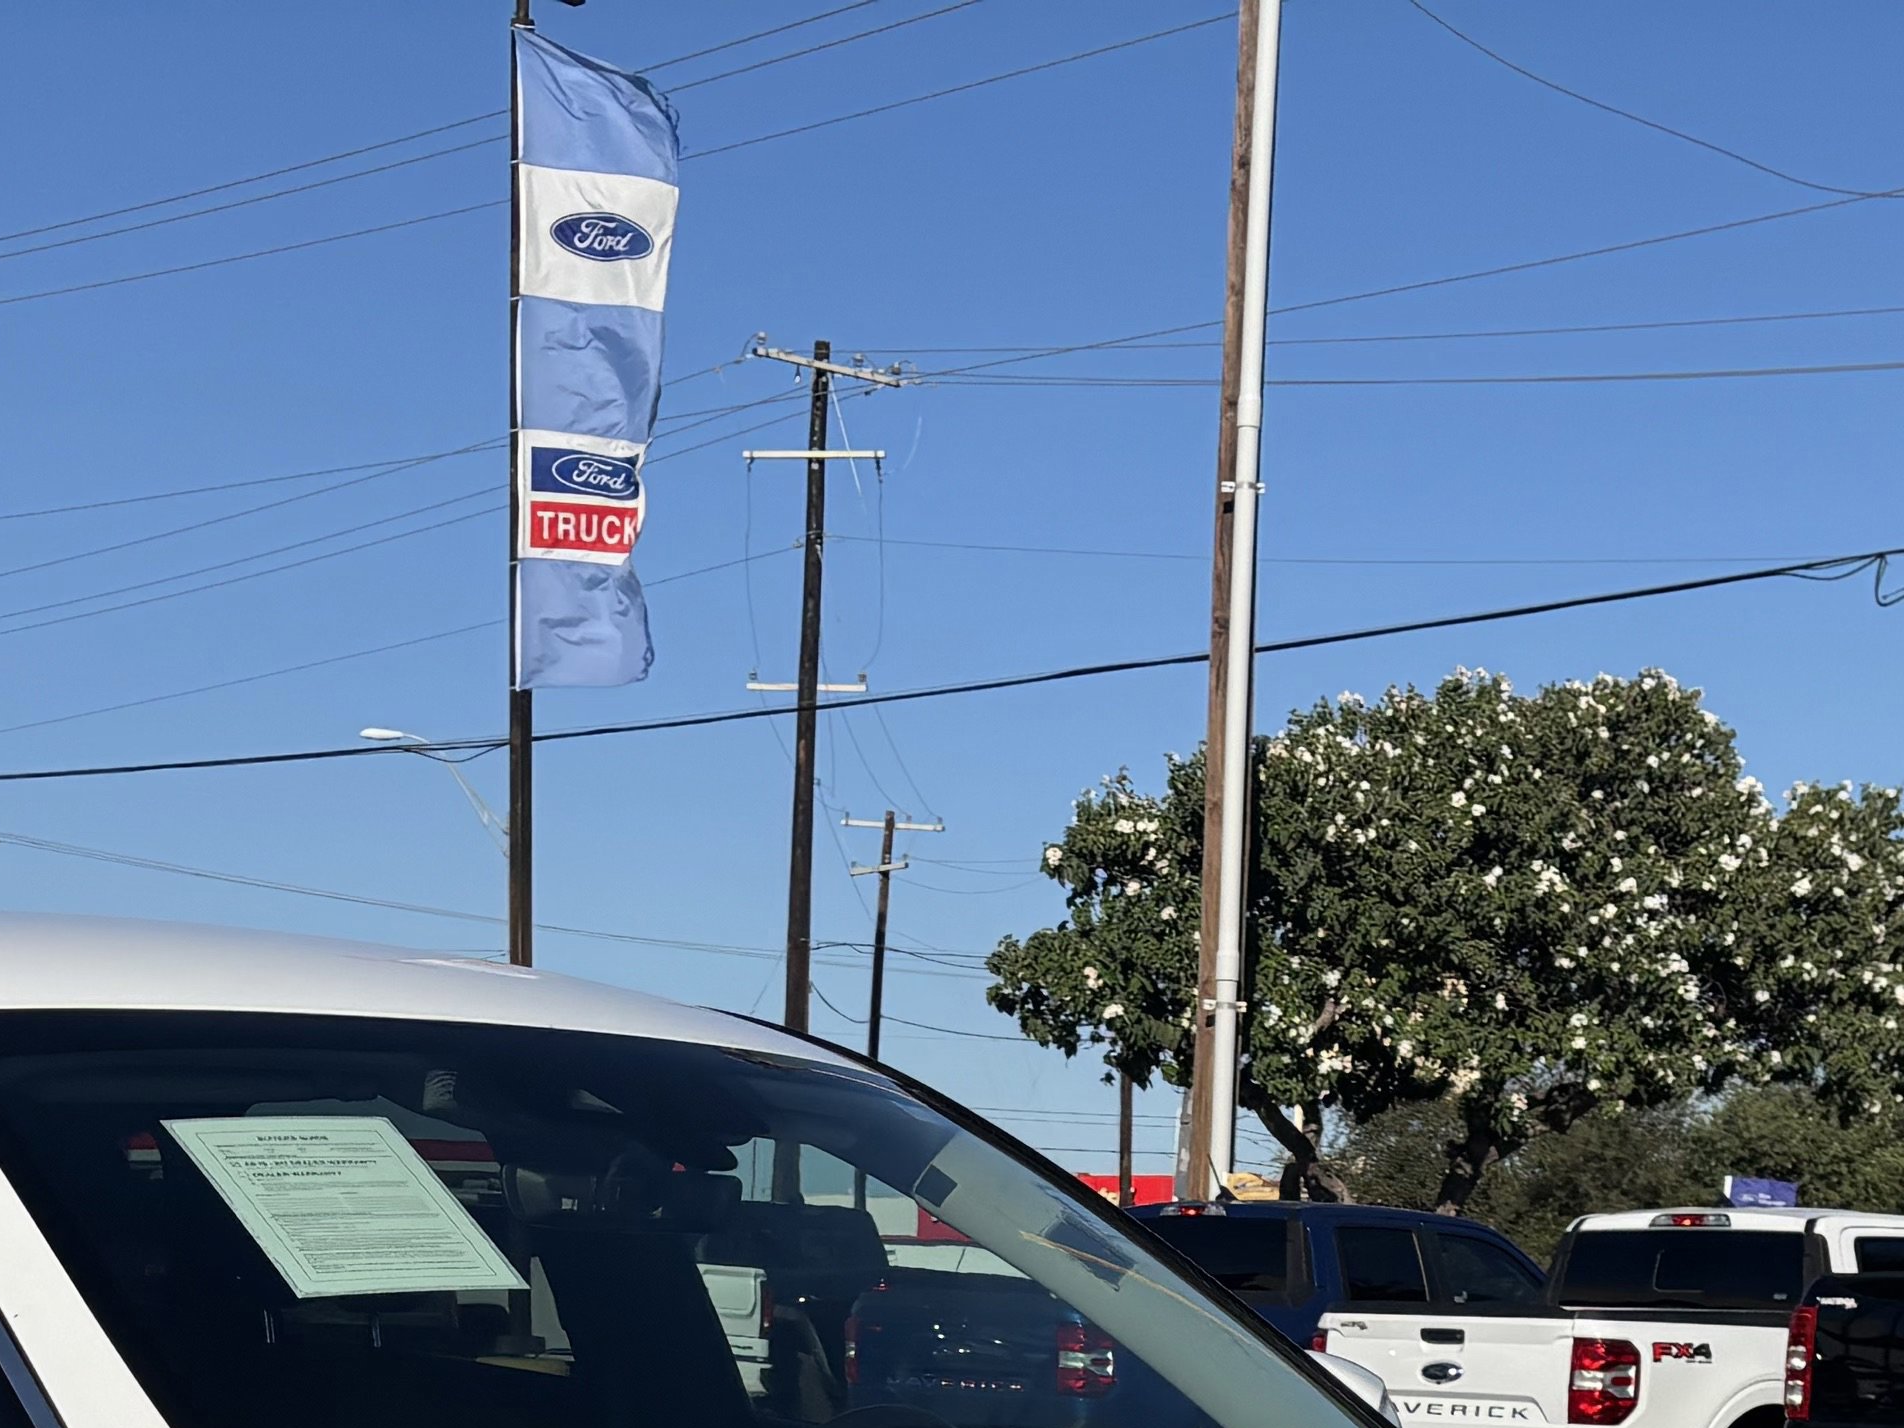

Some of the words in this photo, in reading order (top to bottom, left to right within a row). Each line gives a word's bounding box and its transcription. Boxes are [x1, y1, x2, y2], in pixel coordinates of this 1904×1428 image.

[573, 219, 634, 251] Ford
[572, 460, 626, 489] Ford
[537, 510, 636, 545] TRUCK
[1652, 1342, 1712, 1363] FX4
[1394, 1401, 1529, 1420] VERICK
